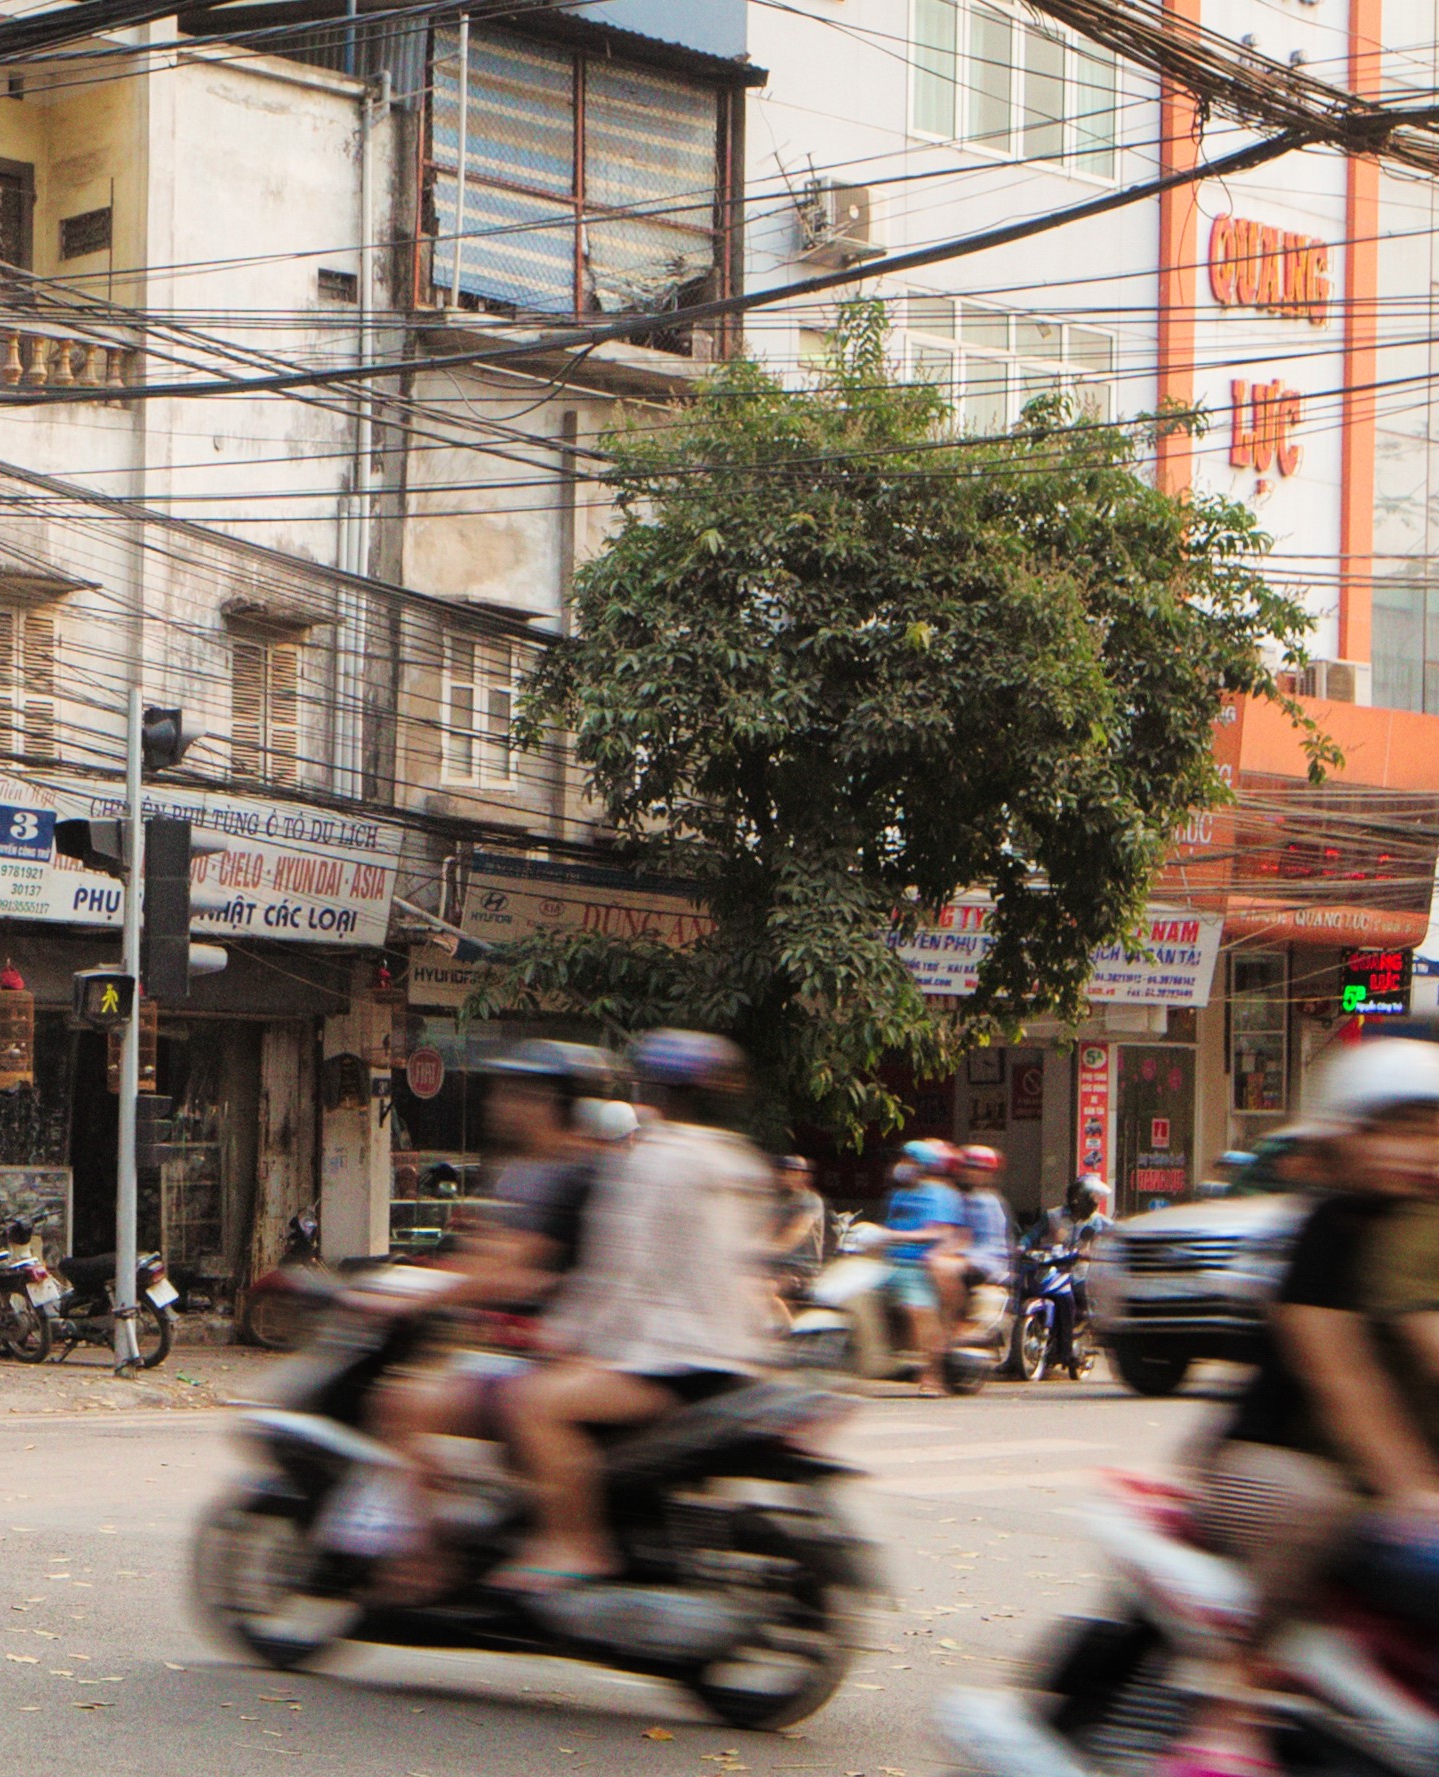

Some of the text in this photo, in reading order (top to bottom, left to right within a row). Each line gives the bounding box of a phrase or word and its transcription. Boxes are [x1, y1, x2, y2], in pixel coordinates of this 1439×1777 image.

[1209, 213, 1330, 325] QUANG
[10, 812, 39, 841] 3
[212, 805, 259, 836] TÙNG
[266, 809, 279, 836] Ô
[284, 812, 305, 839] TÔ
[310, 821, 335, 843] DU
[11, 883, 42, 896] 30137
[219, 851, 264, 888] CIELO
[273, 855, 344, 897] HYUNDAI
[349, 865, 386, 900] ASIA
[73, 884, 121, 921] PHỤ
[264, 899, 300, 928] CÁC
[308, 908, 358, 939] LOẠI
[1295, 909, 1340, 928] QUANG
[1151, 921, 1200, 942] NAM
[1349, 952, 1402, 973] QUANG
